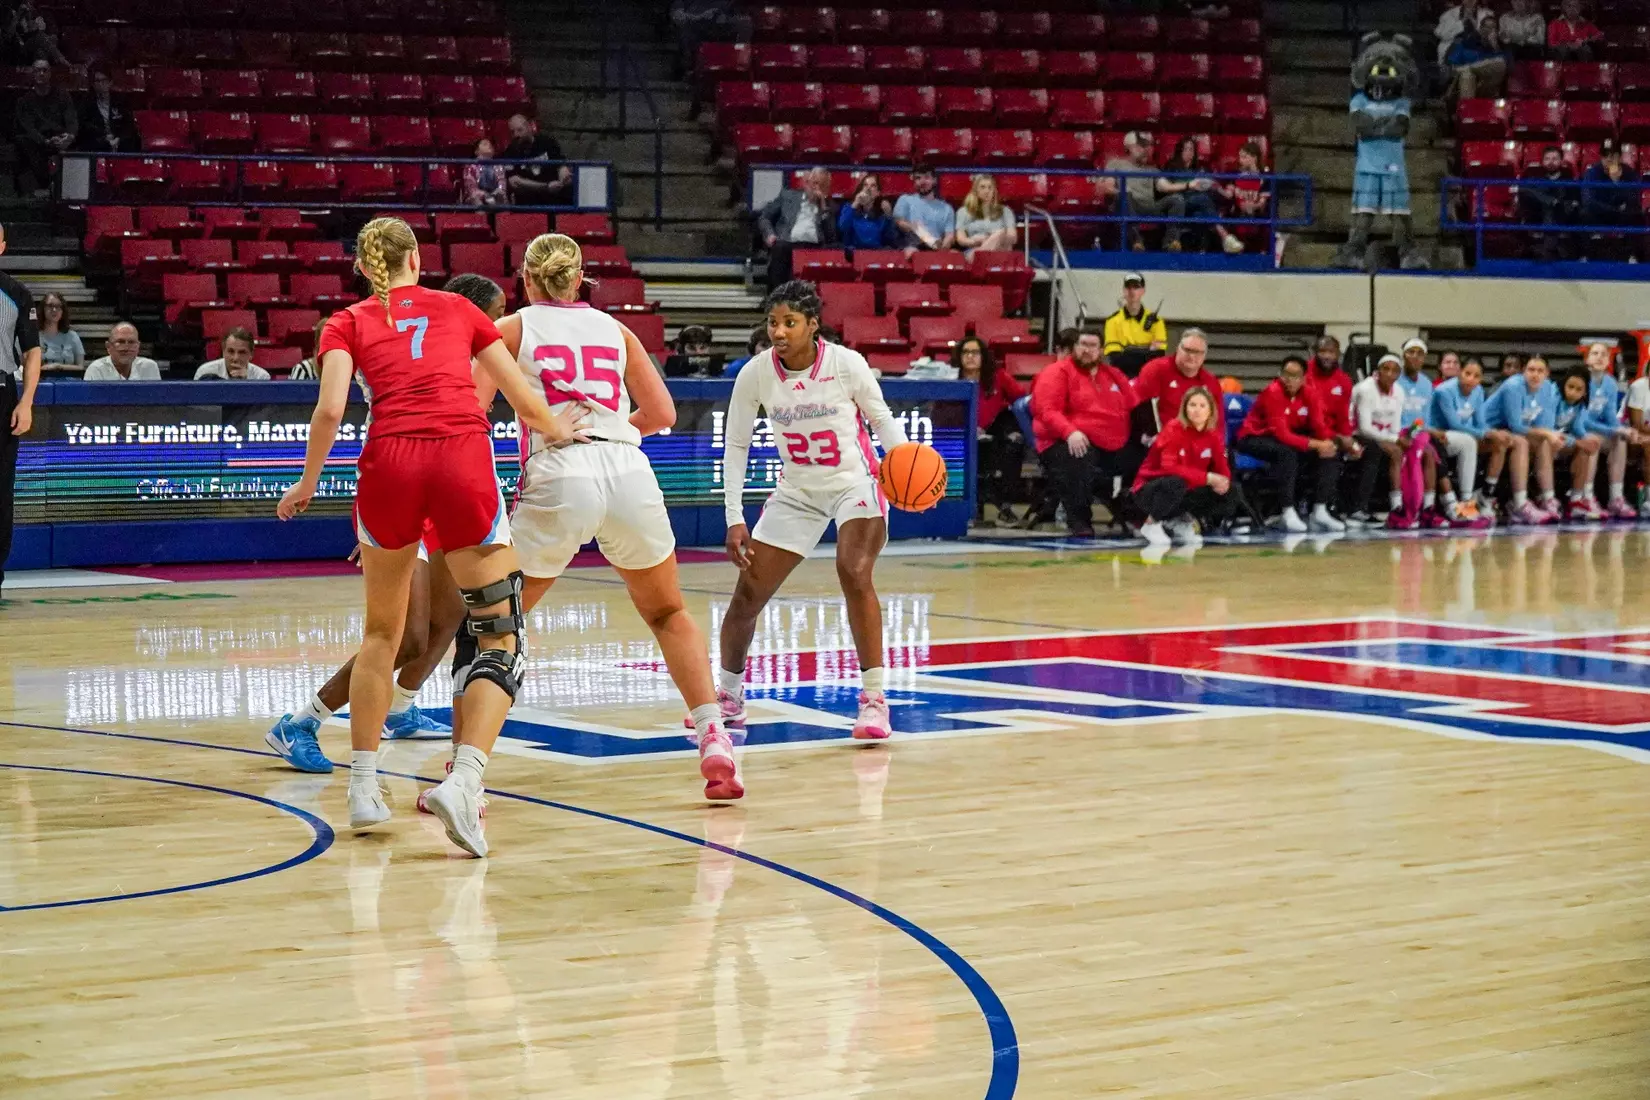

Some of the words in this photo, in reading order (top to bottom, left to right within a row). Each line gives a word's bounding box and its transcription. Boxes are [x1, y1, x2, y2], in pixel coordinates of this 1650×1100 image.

[395, 316, 428, 360] 7
[534, 345, 621, 412] 25
[64, 422, 120, 444] Your
[782, 429, 841, 467] 23
